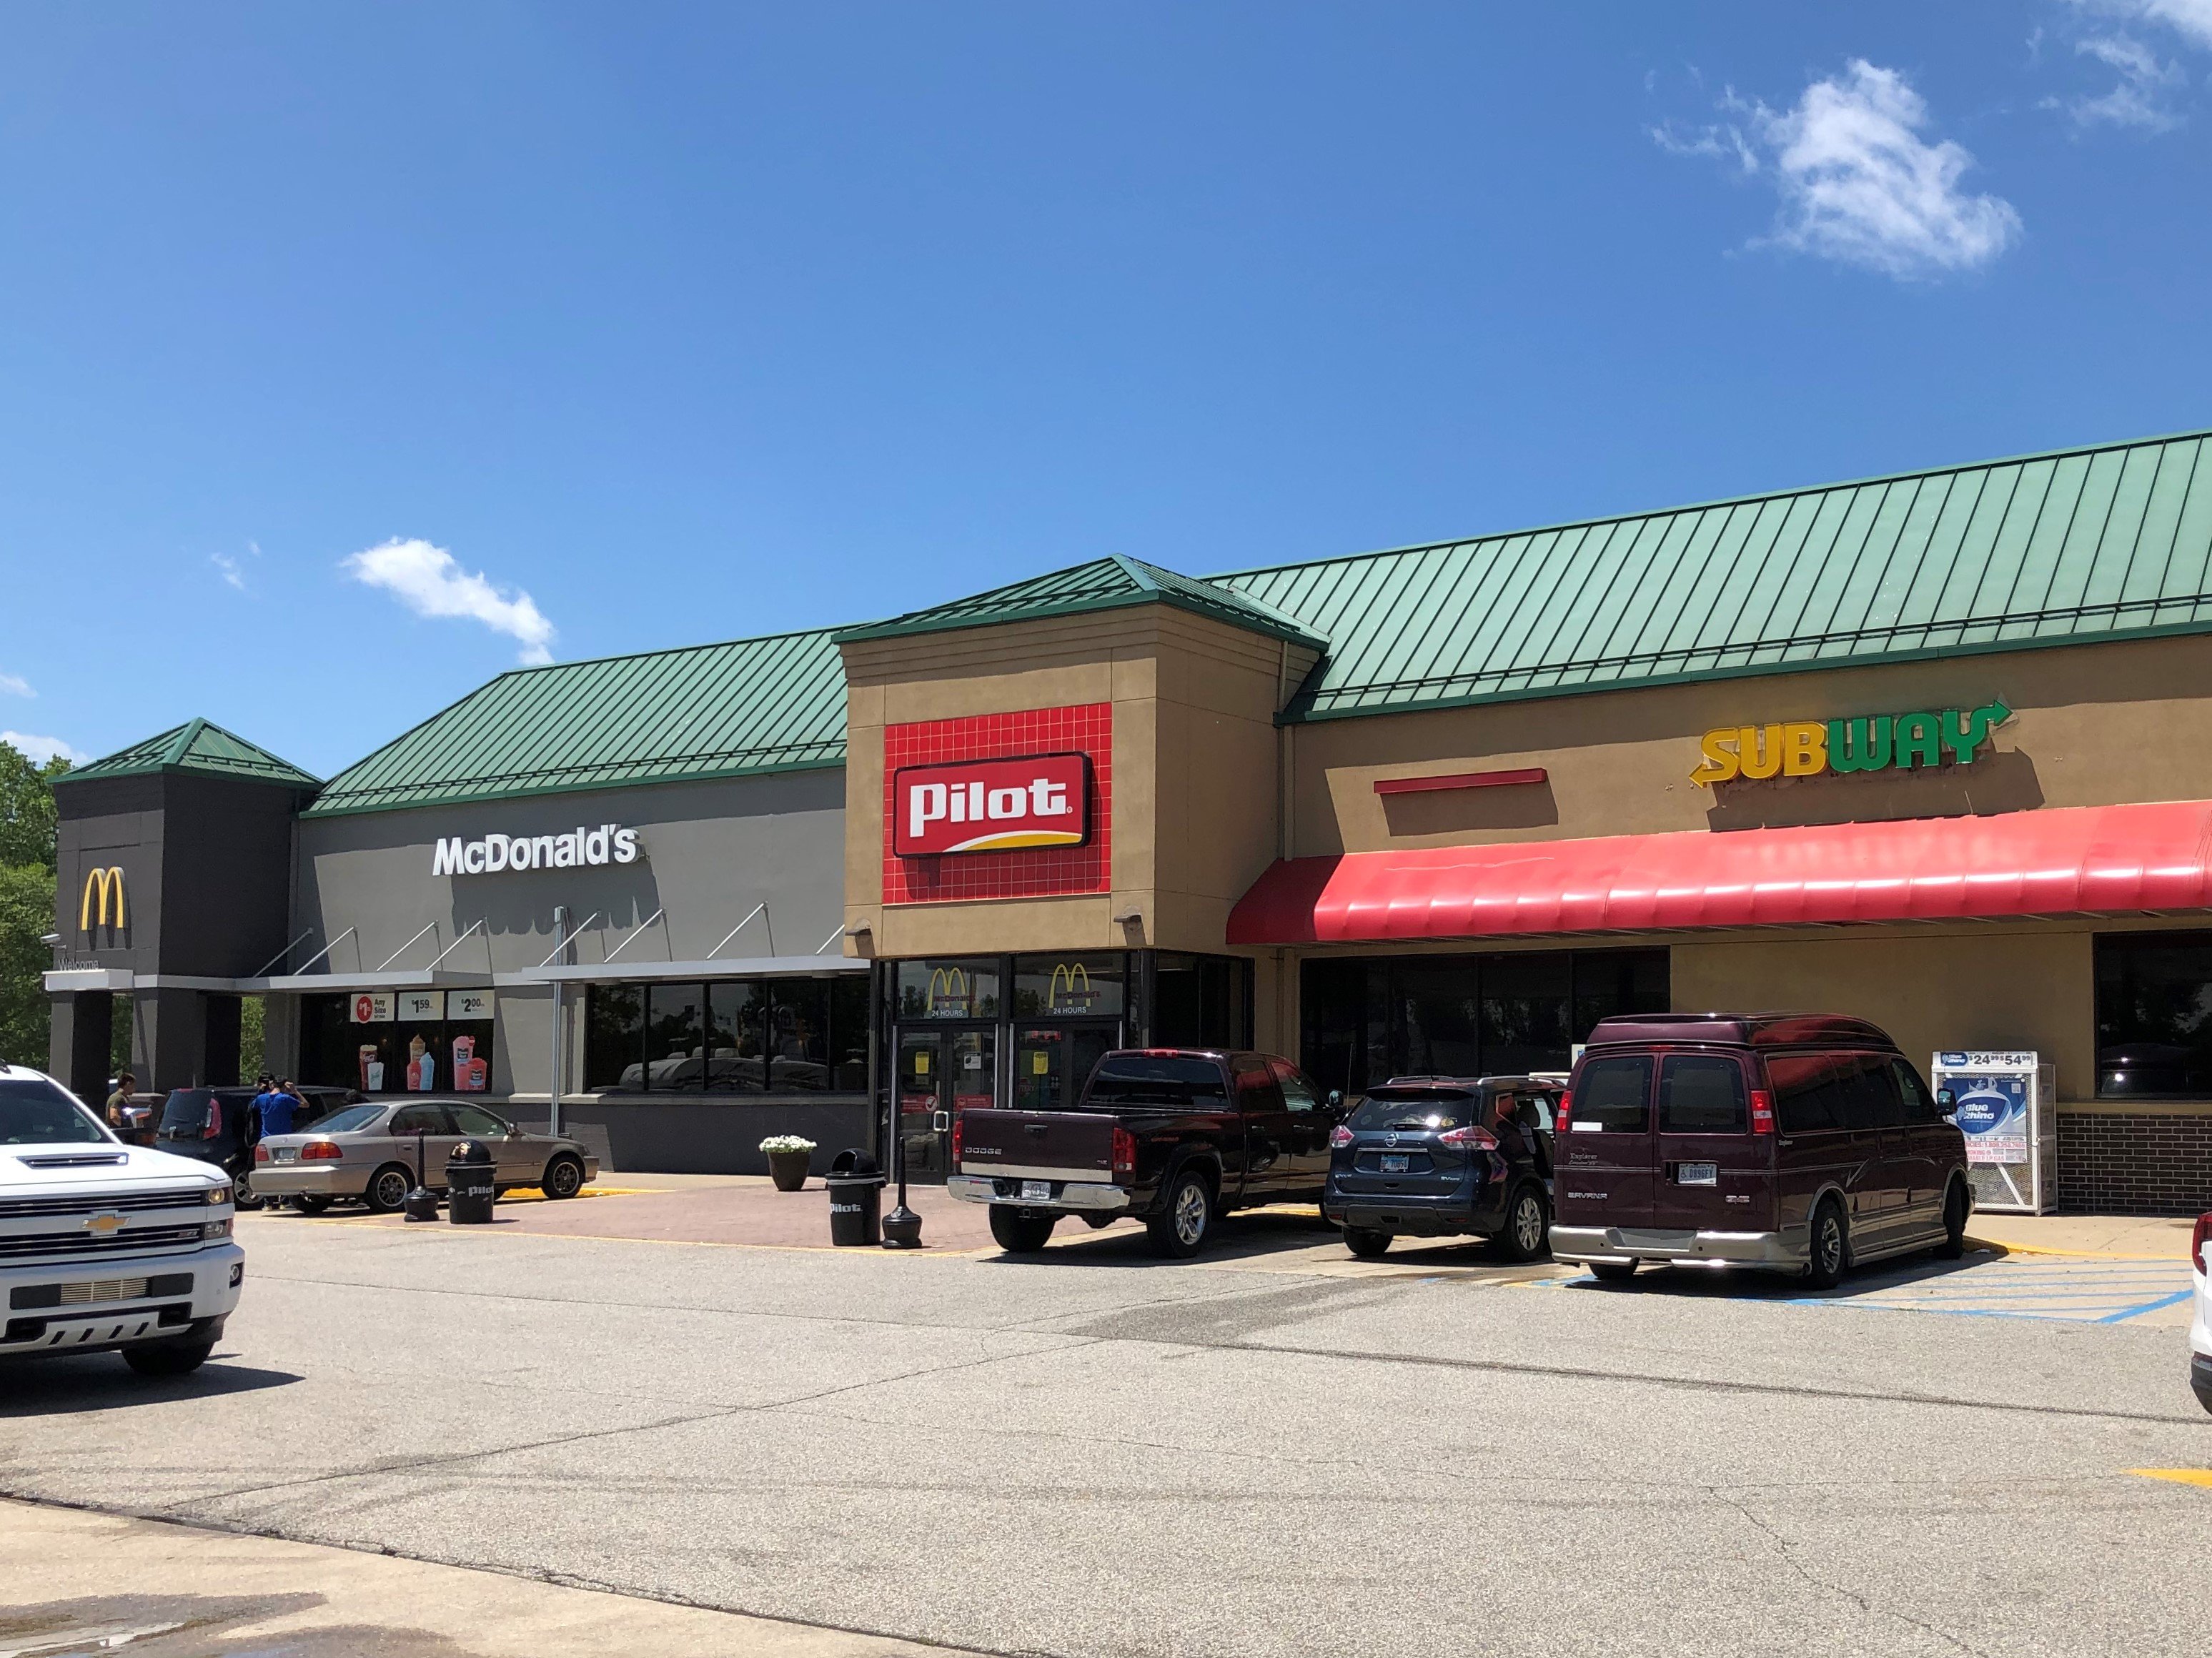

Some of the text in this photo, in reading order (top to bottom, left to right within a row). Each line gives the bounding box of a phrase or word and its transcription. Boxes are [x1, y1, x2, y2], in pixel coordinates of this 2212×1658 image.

[1689, 700, 2013, 788] SUBWAY
[910, 778, 1066, 837] Pilot
[432, 824, 641, 876] McDonald's
[59, 956, 99, 971] Welcome
[375, 998, 386, 1007] Any
[1965, 1103, 1988, 1112] Blue
